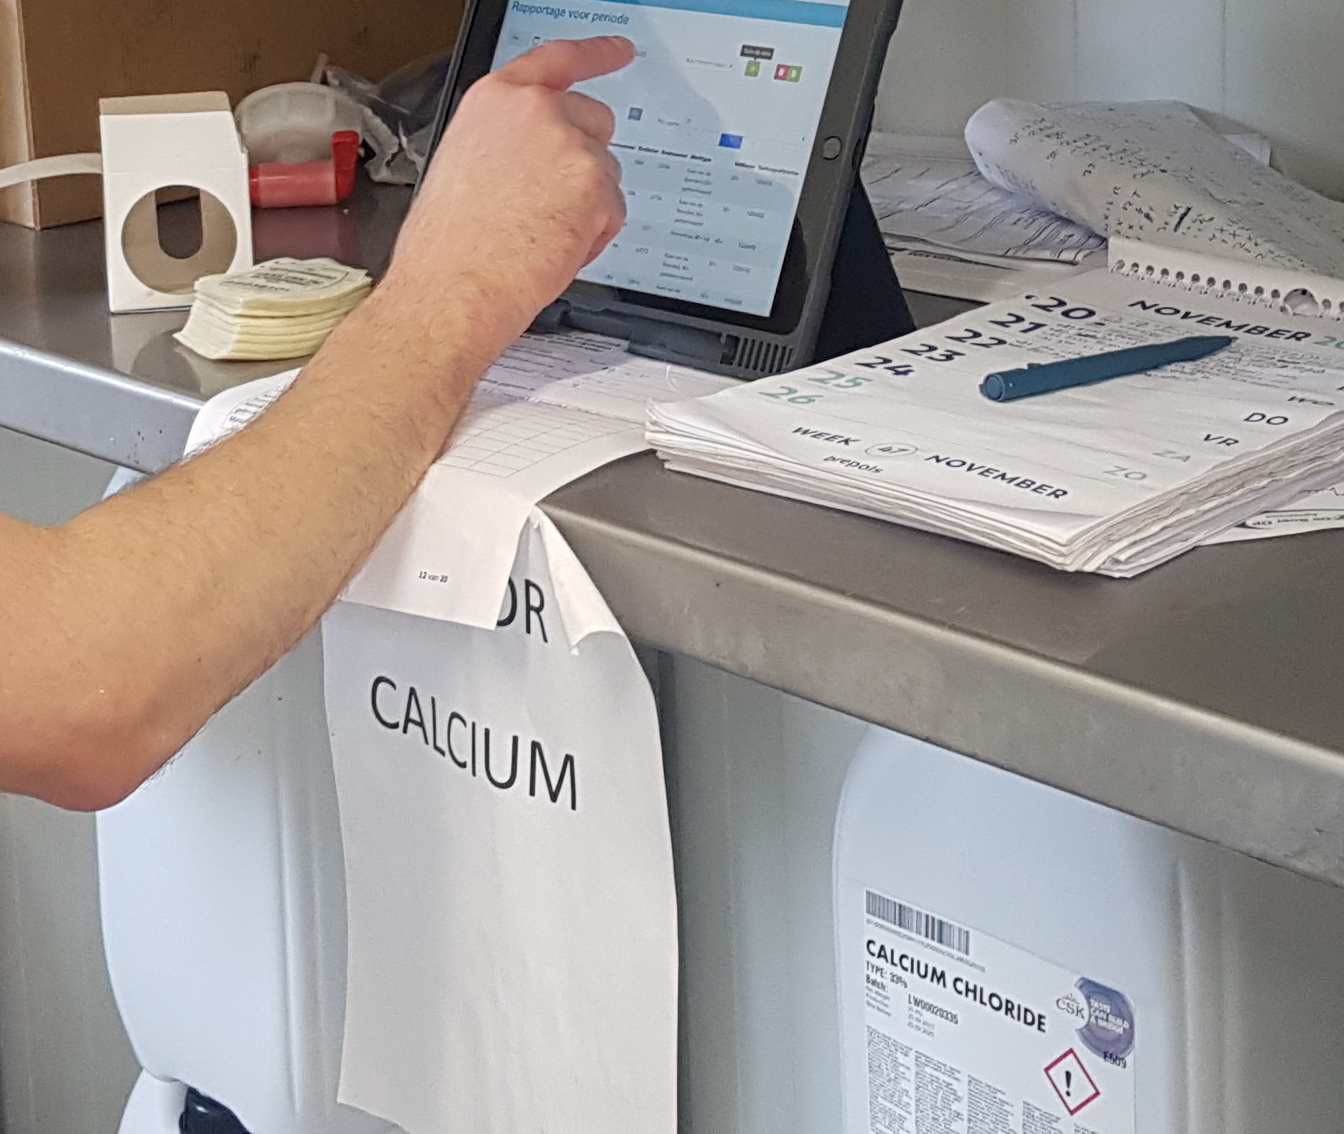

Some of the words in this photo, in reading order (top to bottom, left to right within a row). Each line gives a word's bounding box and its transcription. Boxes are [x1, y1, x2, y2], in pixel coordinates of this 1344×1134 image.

[511, 0, 566, 20] Rapportage
[568, 10, 591, 20] voor
[590, 12, 630, 25] periode
[1030, 296, 1097, 320] 20
[988, 313, 1049, 335] 21
[1128, 300, 1313, 342] NOVEMBER
[945, 328, 1008, 349] 22
[900, 343, 966, 363] 23
[854, 356, 916, 377] 24
[806, 370, 874, 390] 25
[759, 386, 825, 405] 26
[1242, 412, 1289, 427] DO
[1203, 433, 1240, 448] VR
[791, 426, 861, 446] WEEK
[923, 453, 1069, 500] NOVEMBER
[1102, 465, 1149, 482] ZO
[370, 675, 577, 812] CALCIUM
[866, 938, 947, 989] CALCIUM
[952, 976, 1047, 1034] CHLORIDE
[1055, 997, 1085, 1020] CSK
